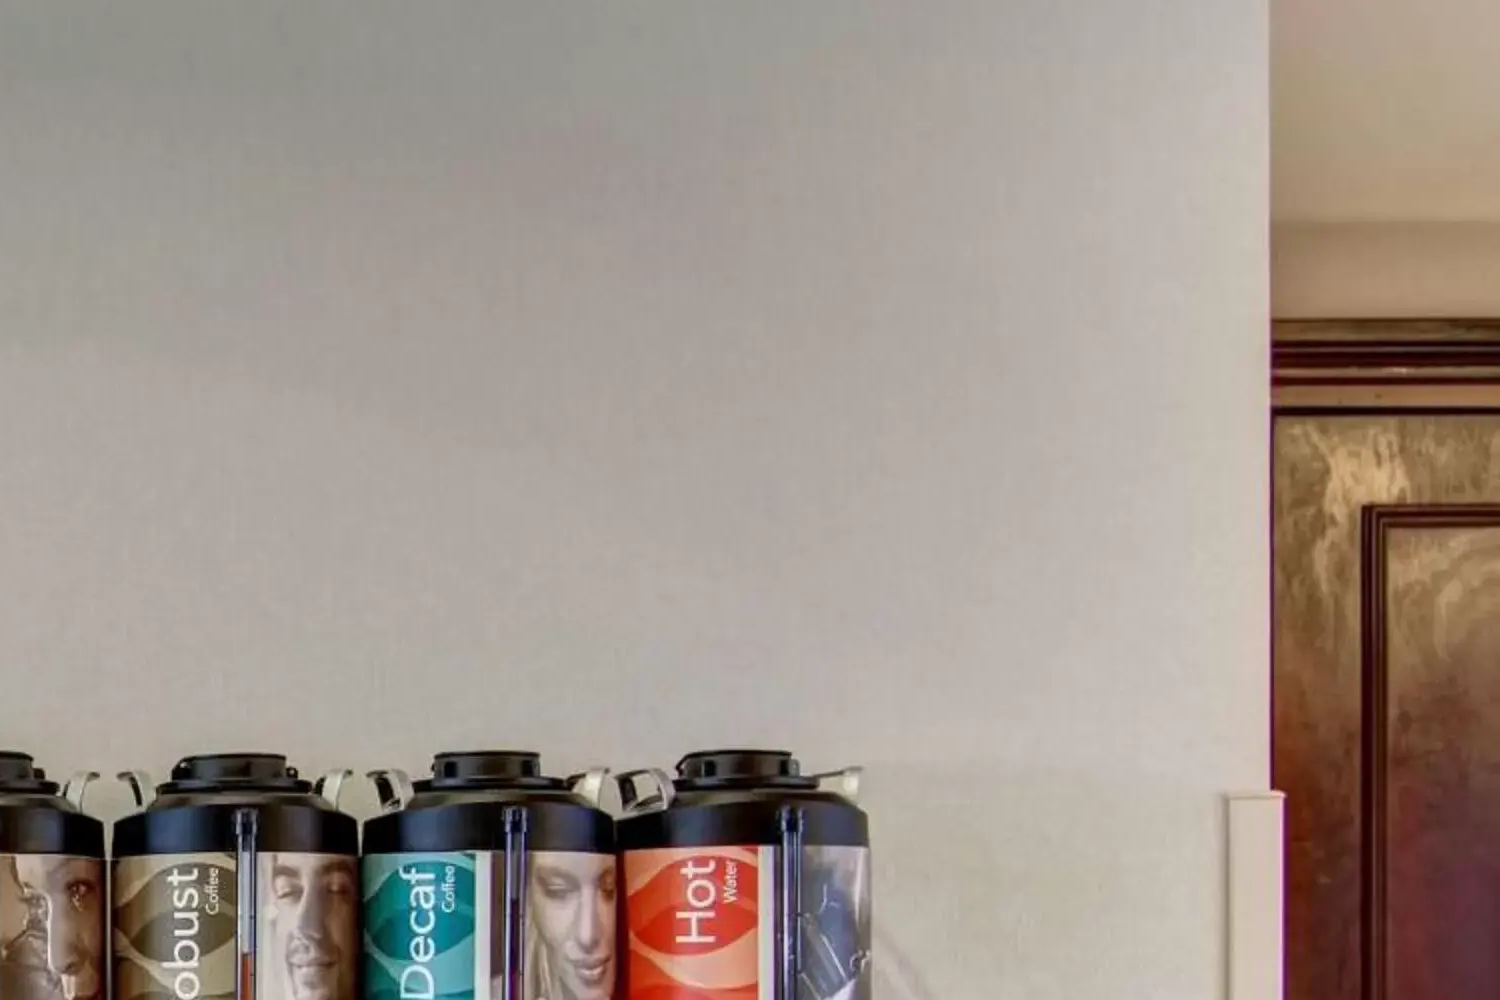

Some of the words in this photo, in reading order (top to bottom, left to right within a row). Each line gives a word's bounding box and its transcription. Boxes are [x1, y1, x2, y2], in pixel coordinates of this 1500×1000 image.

[205, 867, 220, 916] Coffee
[441, 864, 456, 914] Coffee
[675, 857, 717, 945] Hot
[722, 859, 738, 905] Water
